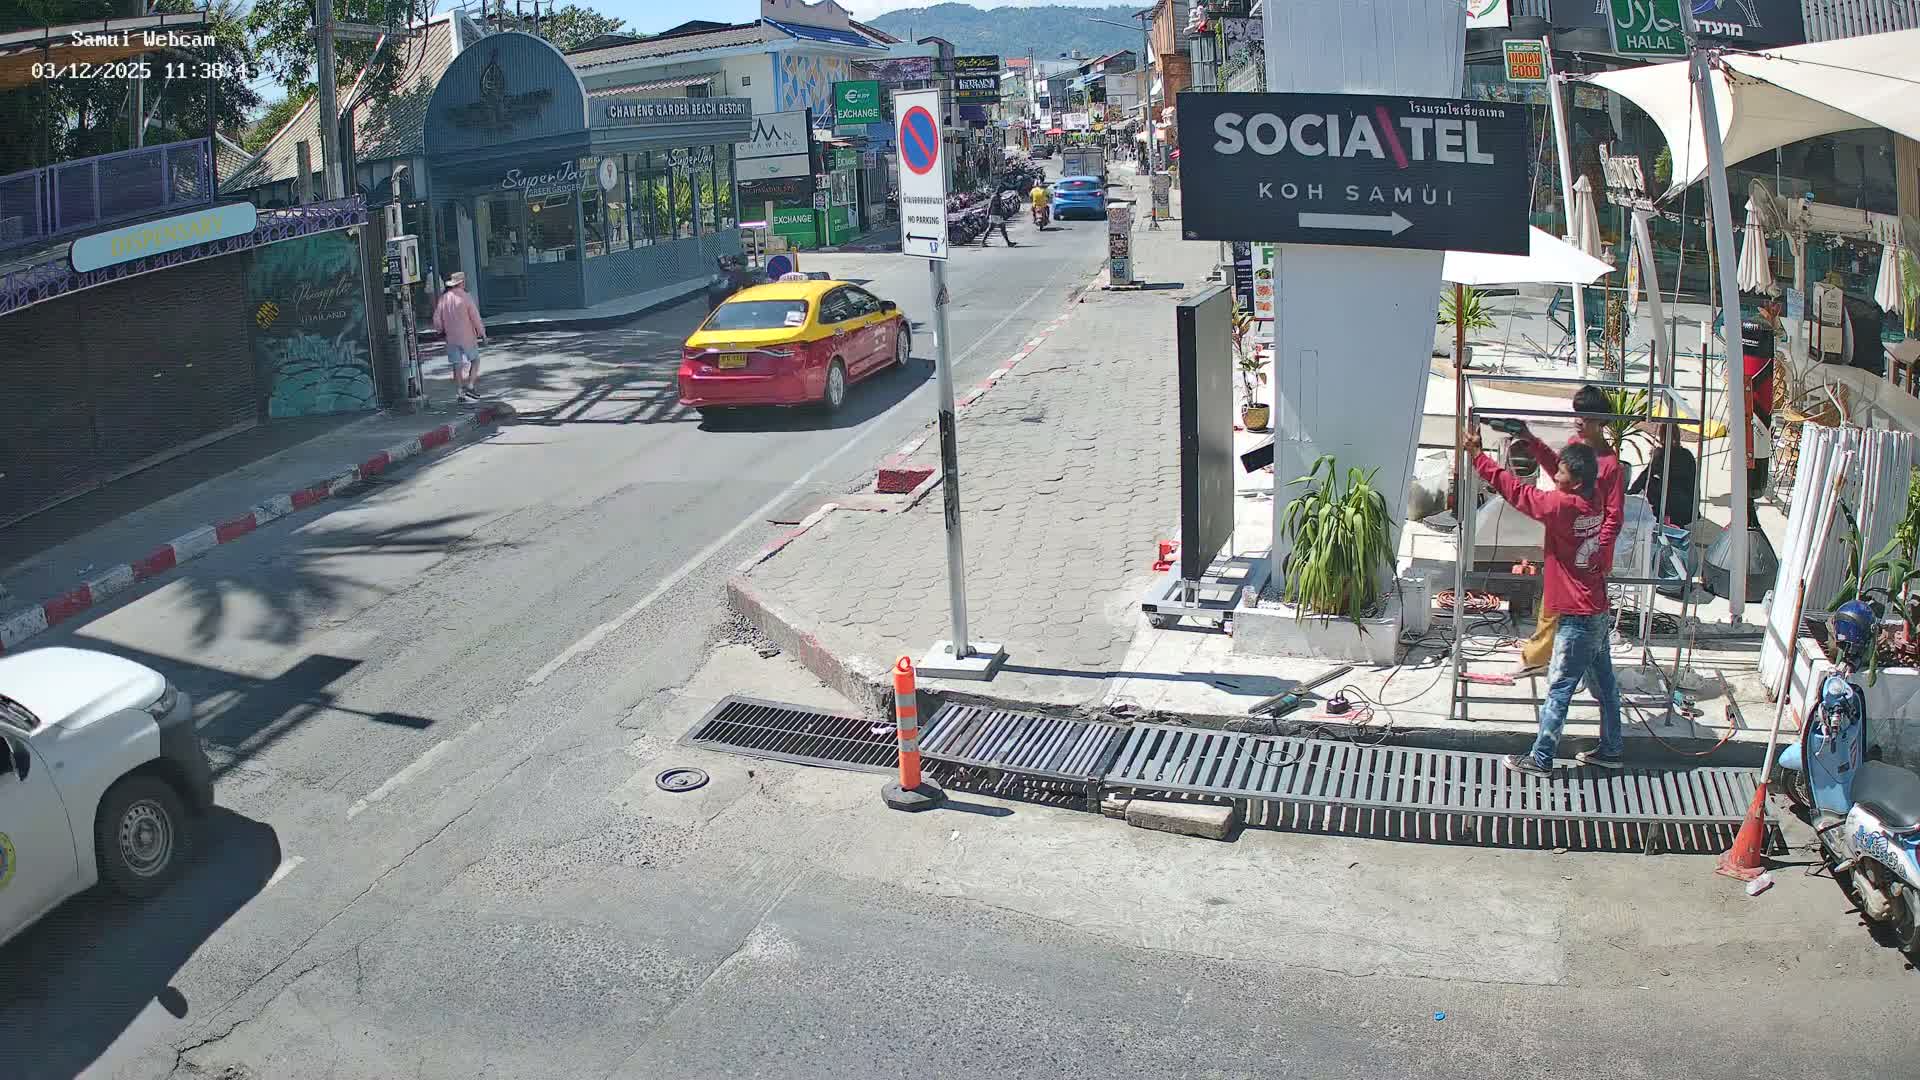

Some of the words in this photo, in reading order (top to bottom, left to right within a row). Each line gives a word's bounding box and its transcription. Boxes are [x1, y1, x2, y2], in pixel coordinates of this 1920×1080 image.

[1626, 35, 1676, 50] HALAL
[1507, 51, 1542, 64] INDIAN
[1511, 65, 1541, 78] FOOD
[610, 104, 654, 118] CHAWENG
[655, 103, 690, 116] GARDEN
[691, 103, 717, 115] BEACH
[719, 103, 746, 114] RESORT
[838, 108, 879, 119] EXCHANGE
[1258, 182, 1325, 201] KOH
[1345, 184, 1453, 206] SAMUI
[773, 214, 813, 225] EXCHANGE
[907, 215, 915, 224] NO
[916, 216, 940, 225] PARKING
[111, 208, 226, 257] DISPENSARY
